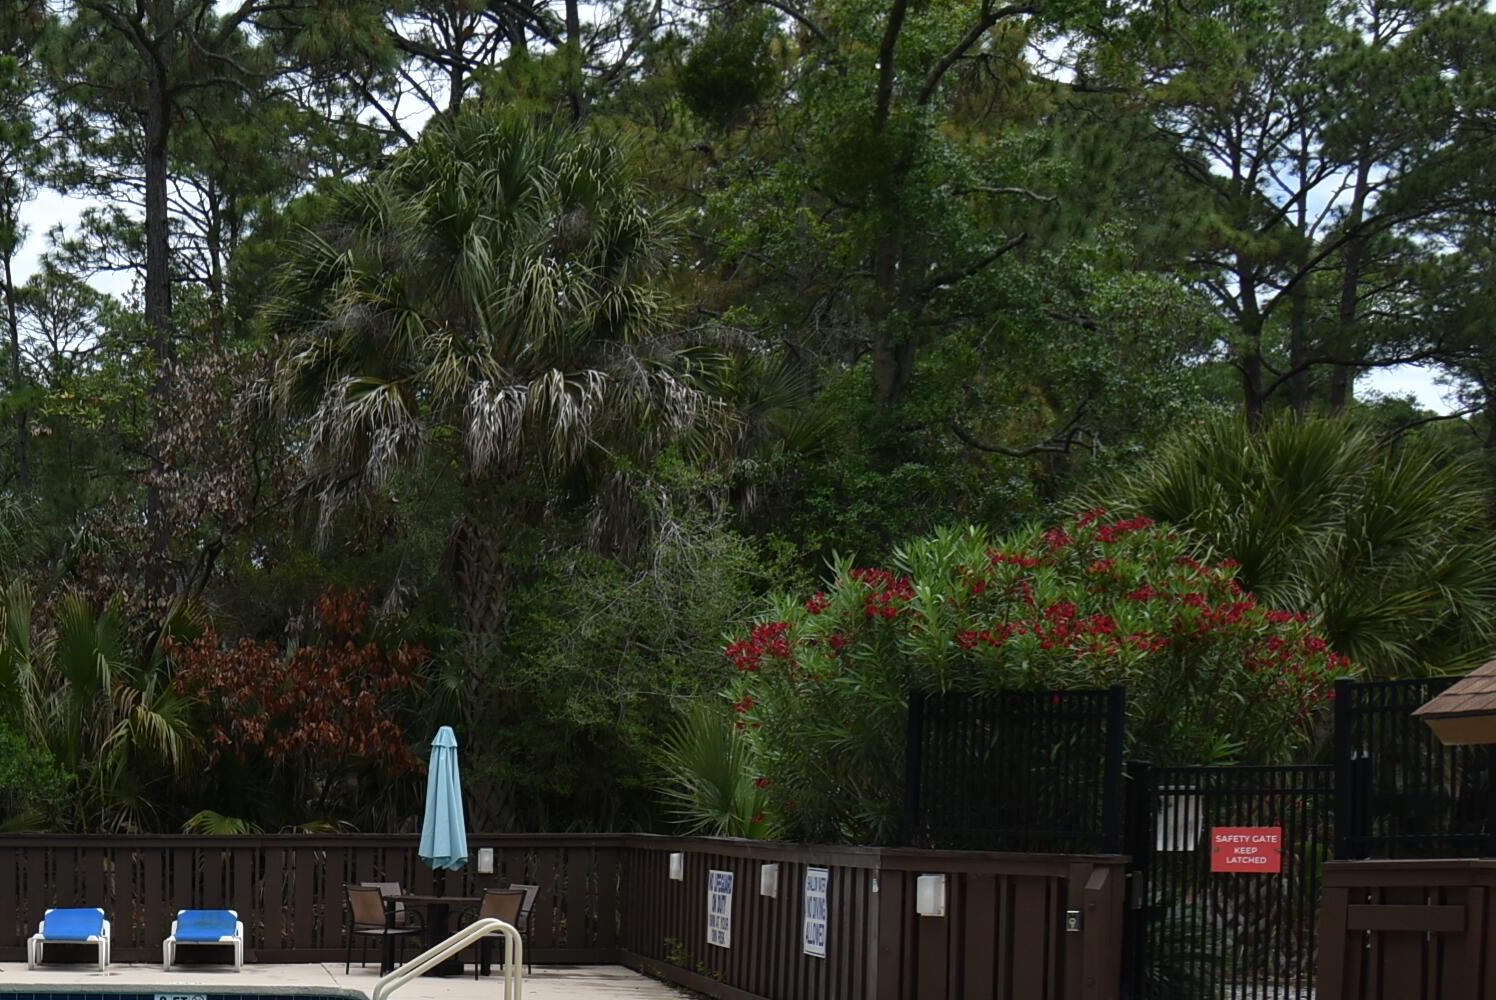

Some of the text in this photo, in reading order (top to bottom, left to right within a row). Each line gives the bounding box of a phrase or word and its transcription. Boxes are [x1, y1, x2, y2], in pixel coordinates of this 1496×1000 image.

[1215, 835, 1278, 843] SAFETY GATE
[1233, 846, 1258, 854] KEEP
[1225, 856, 1267, 864] LATCHED
